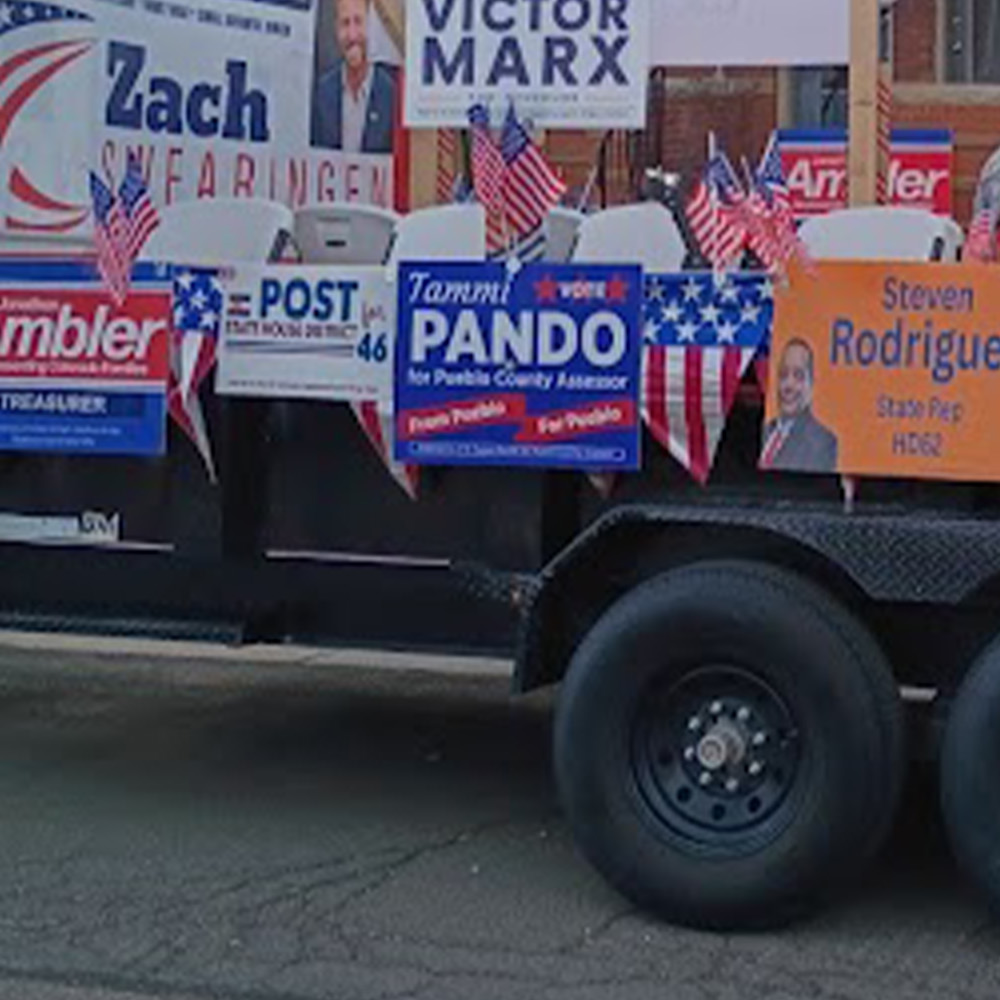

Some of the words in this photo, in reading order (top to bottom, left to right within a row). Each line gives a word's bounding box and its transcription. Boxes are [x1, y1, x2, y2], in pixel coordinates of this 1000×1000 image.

[422, 35, 630, 87] MARX
[105, 40, 271, 143] Zach
[786, 159, 950, 200] Amler
[260, 278, 359, 321] POST
[409, 271, 512, 304] Tammi
[883, 276, 974, 312] Steven
[357, 332, 388, 363] 46
[411, 310, 627, 368] PANDO
[877, 394, 924, 418] State
[892, 431, 942, 457] HD62
